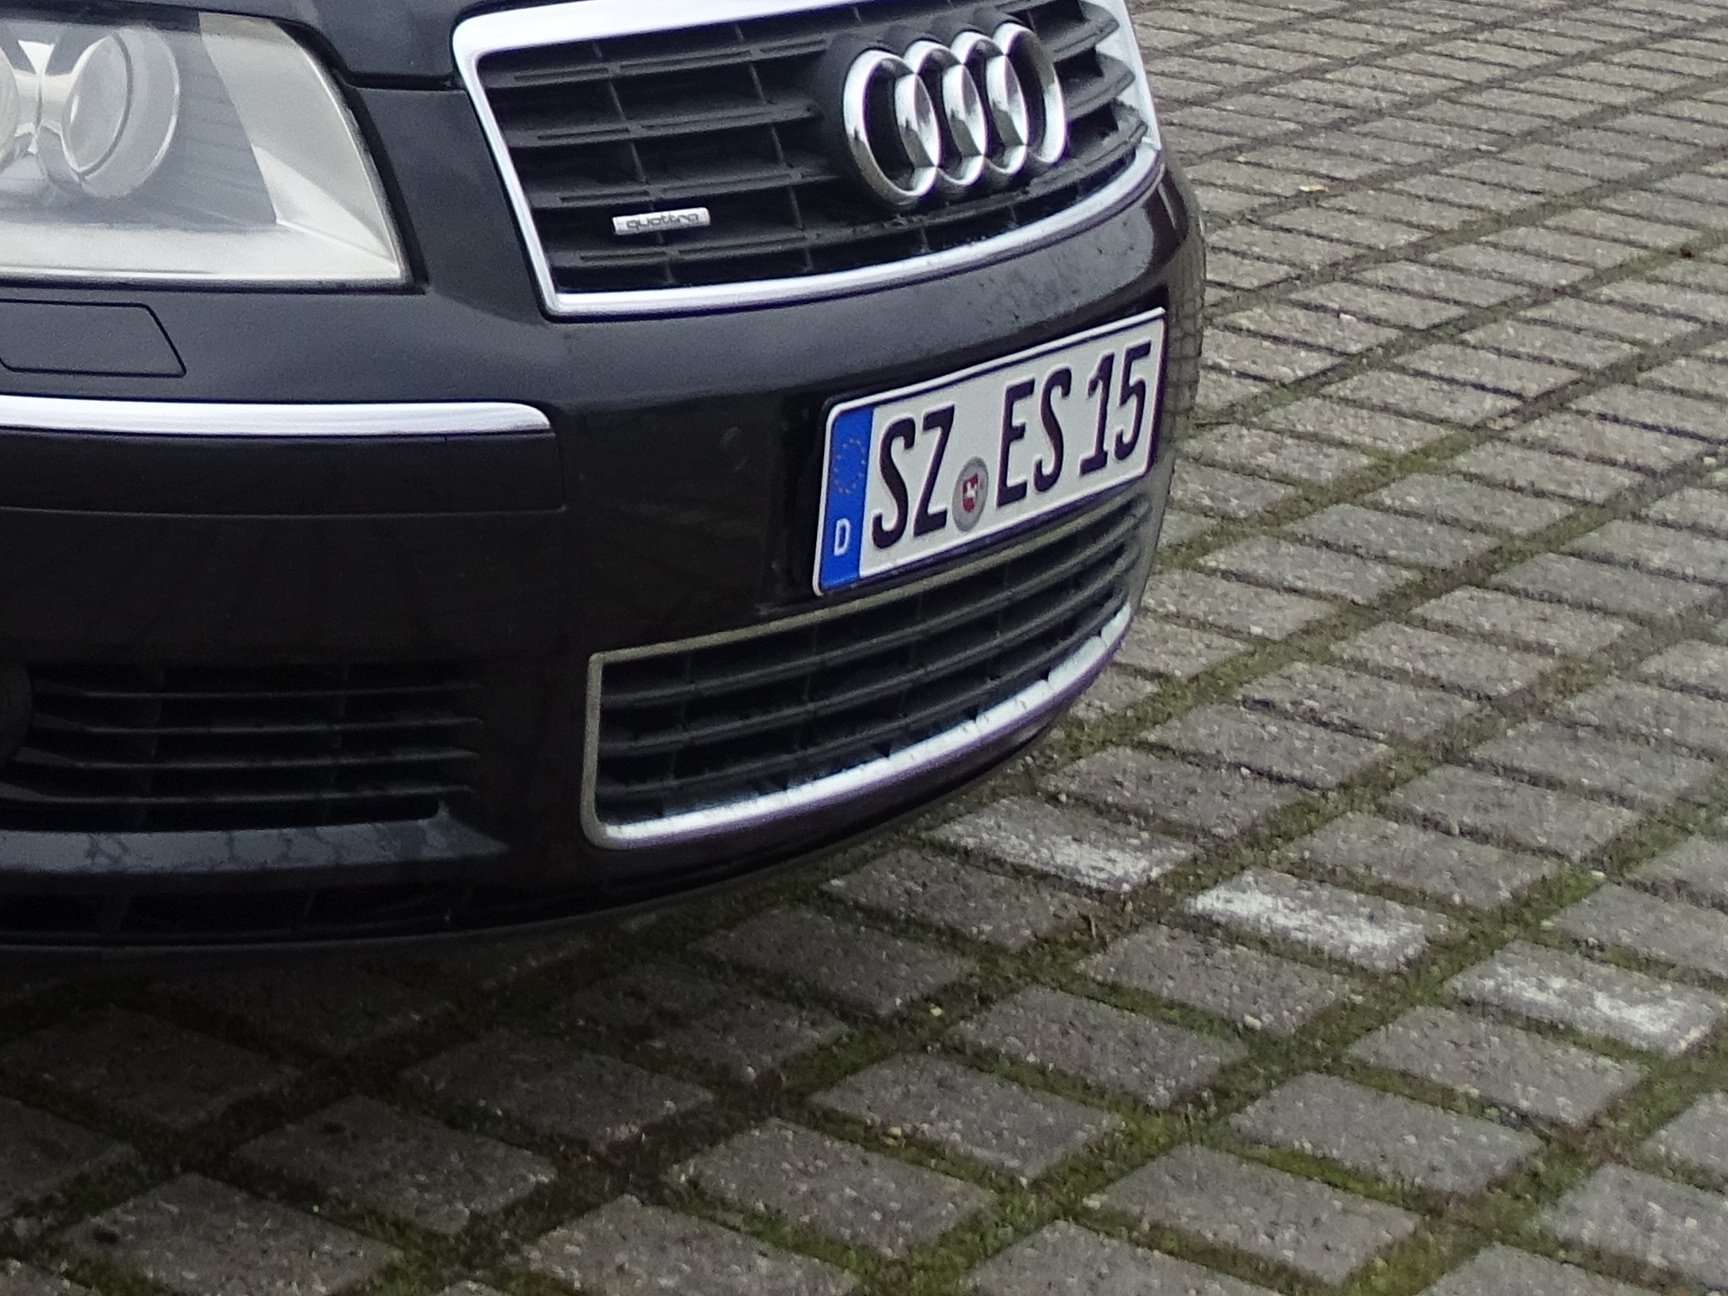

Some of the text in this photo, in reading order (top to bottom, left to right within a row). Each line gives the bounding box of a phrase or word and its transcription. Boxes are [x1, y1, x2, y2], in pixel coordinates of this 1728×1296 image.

[625, 212, 699, 231] quattro
[871, 340, 1152, 549] SZ ES 15
[833, 518, 851, 556] D
